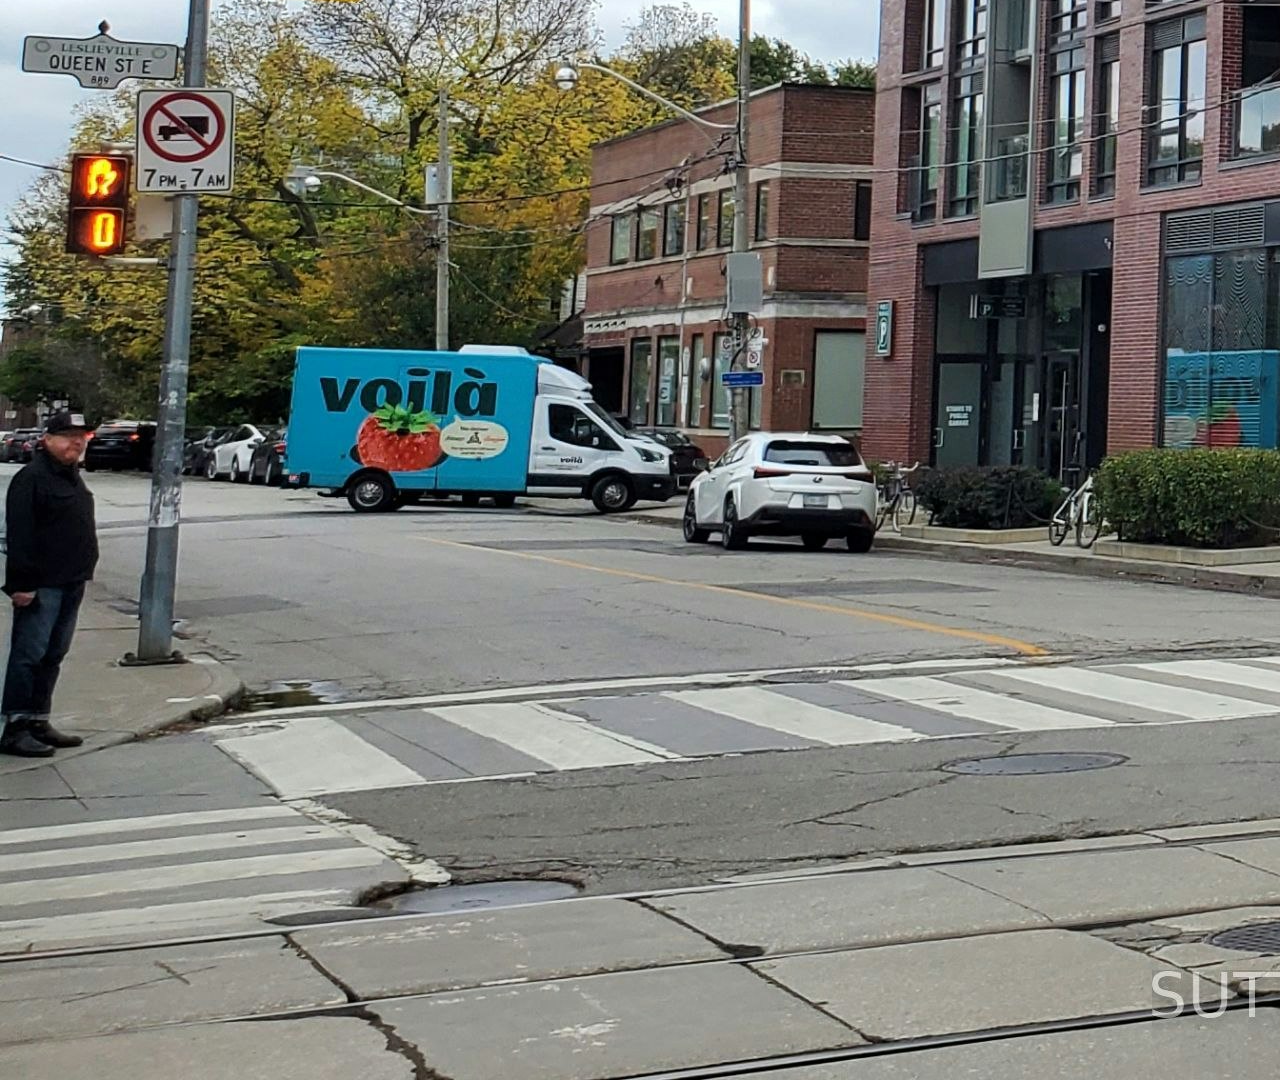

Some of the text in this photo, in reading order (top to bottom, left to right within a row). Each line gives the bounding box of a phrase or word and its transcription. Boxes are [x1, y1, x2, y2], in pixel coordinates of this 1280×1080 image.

[61, 43, 144, 57] LESLIEVILLE
[50, 54, 152, 74] QUEEN ST E
[320, 367, 498, 417] voilà
[560, 455, 583, 464] voilà
